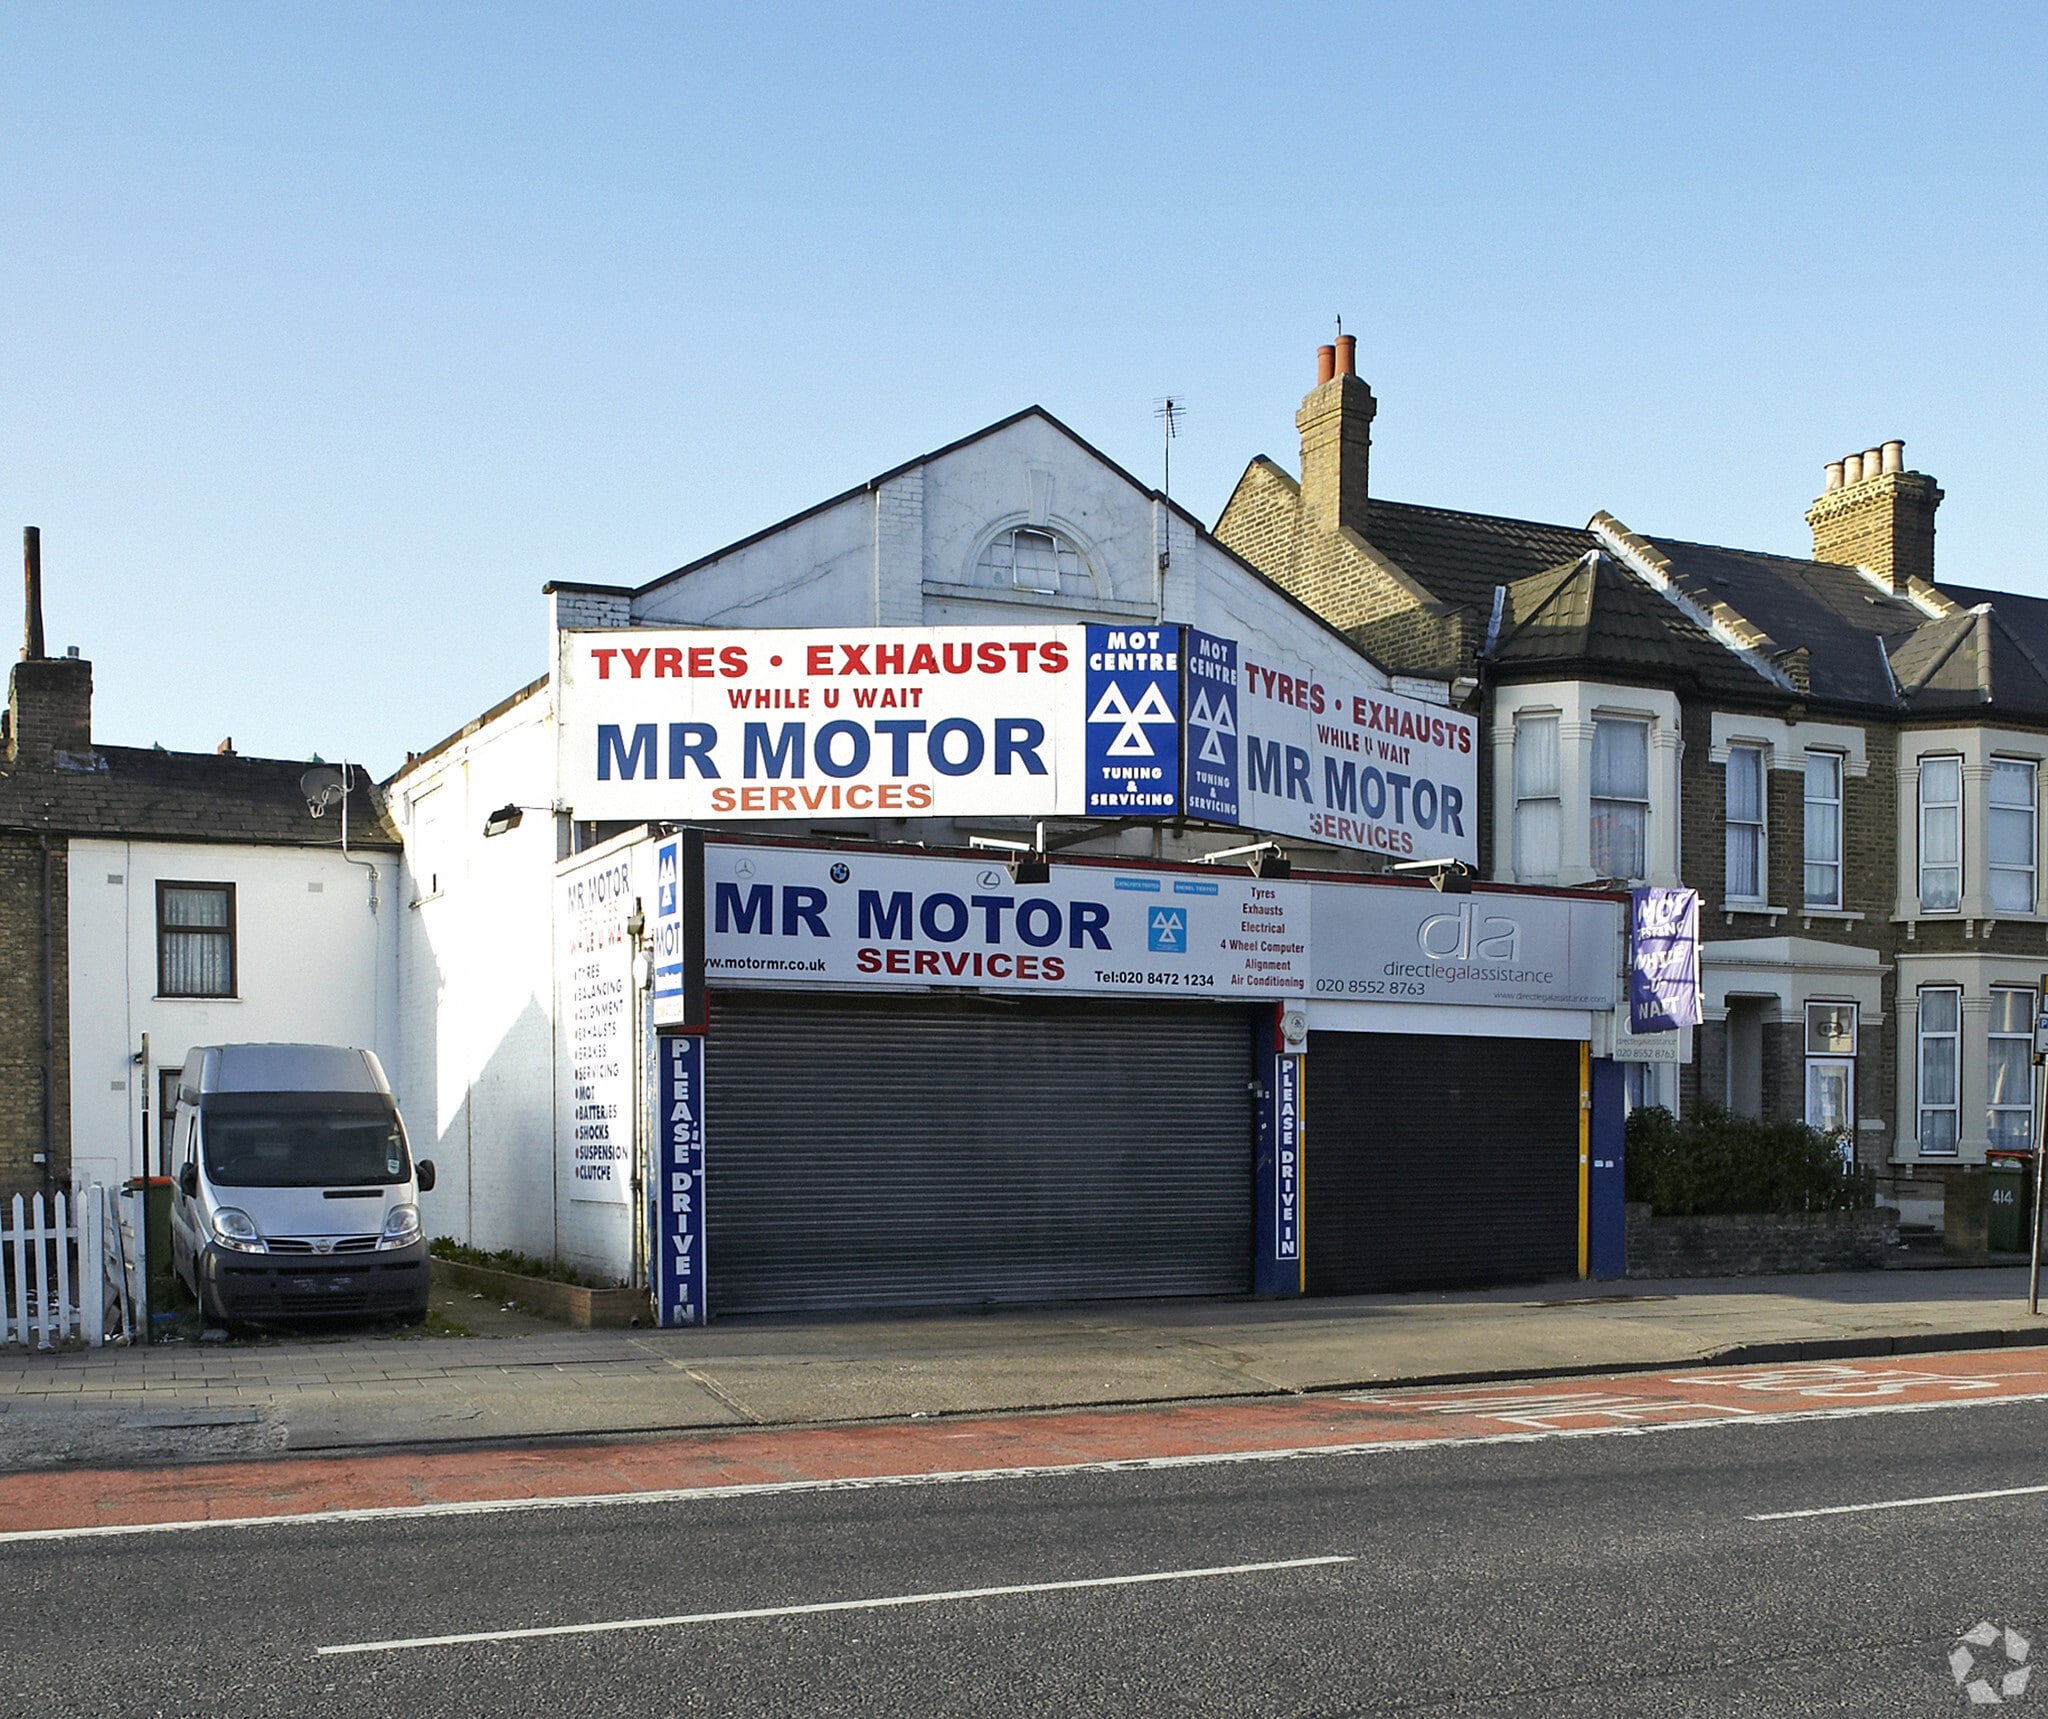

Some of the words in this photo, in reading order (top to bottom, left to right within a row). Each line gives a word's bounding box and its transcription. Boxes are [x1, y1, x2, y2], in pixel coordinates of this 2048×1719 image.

[1107, 631, 1160, 650] MOT
[1199, 637, 1228, 663] MOT
[591, 646, 748, 679] TYRES
[807, 642, 1069, 676] EXHAUSTS
[1089, 653, 1178, 671] CENTRE
[1189, 655, 1238, 687] CENTRE
[728, 688, 809, 709] WHILE
[824, 688, 839, 708] U
[853, 688, 923, 708] WAIT
[1245, 662, 1326, 714] TYRES
[1353, 695, 1472, 755] EXHAUSTS
[597, 722, 721, 781] MR
[743, 717, 1049, 779] MOTOR
[1317, 724, 1360, 753] WHILE
[1365, 736, 1374, 756] U
[1378, 740, 1411, 766] WAIT
[1102, 767, 1163, 780] TUNING
[1196, 770, 1231, 788] TUNING
[1126, 780, 1138, 793] &
[1210, 787, 1217, 799] &
[1247, 735, 1314, 805] MR
[1324, 755, 1466, 838] MOTOR
[711, 784, 932, 812] SERVICES
[1090, 793, 1174, 806] SERVICING
[1189, 795, 1238, 816] SERVICING
[1309, 812, 1414, 855] SERVICES
[587, 863, 630, 907] MOTOR
[1251, 887, 1276, 900] Tyres
[715, 882, 831, 938] MR
[858, 889, 1112, 950] MOTOR
[1242, 903, 1284, 916] Exhausts
[1241, 921, 1285, 934] Electrical
[1416, 902, 1522, 962] dla
[655, 921, 681, 957] MOT
[1220, 939, 1227, 950] 4
[1229, 939, 1258, 952] Wheel
[1260, 941, 1305, 955] Computer
[856, 947, 1066, 982] SERVICES
[1245, 958, 1291, 972] Alignment
[1383, 961, 1554, 983] directlegalassistance
[1094, 970, 1143, 984] Tel:020
[1147, 972, 1179, 985] 8472
[1183, 974, 1214, 987] 1234
[1231, 974, 1244, 985] Air
[1247, 975, 1305, 990] Conditioning
[1316, 978, 1344, 993] 020
[1348, 980, 1385, 994] 8552
[1389, 982, 1425, 996] 8763
[1616, 1048, 1632, 1057] 020
[1633, 1049, 1653, 1058] 8552
[1655, 1049, 1676, 1059] 8763
[670, 1038, 694, 1164] PLEASE
[1281, 1059, 1295, 1145] PLEASE
[579, 1125, 609, 1140] SHOCKS
[579, 1144, 628, 1160] SUSPENSION
[1281, 1153, 1295, 1221] DRIVE
[1992, 1188, 2014, 1206] 414
[671, 1171, 694, 1276] DRIVE
[1281, 1226, 1294, 1254] IN
[673, 1282, 695, 1325] IN
